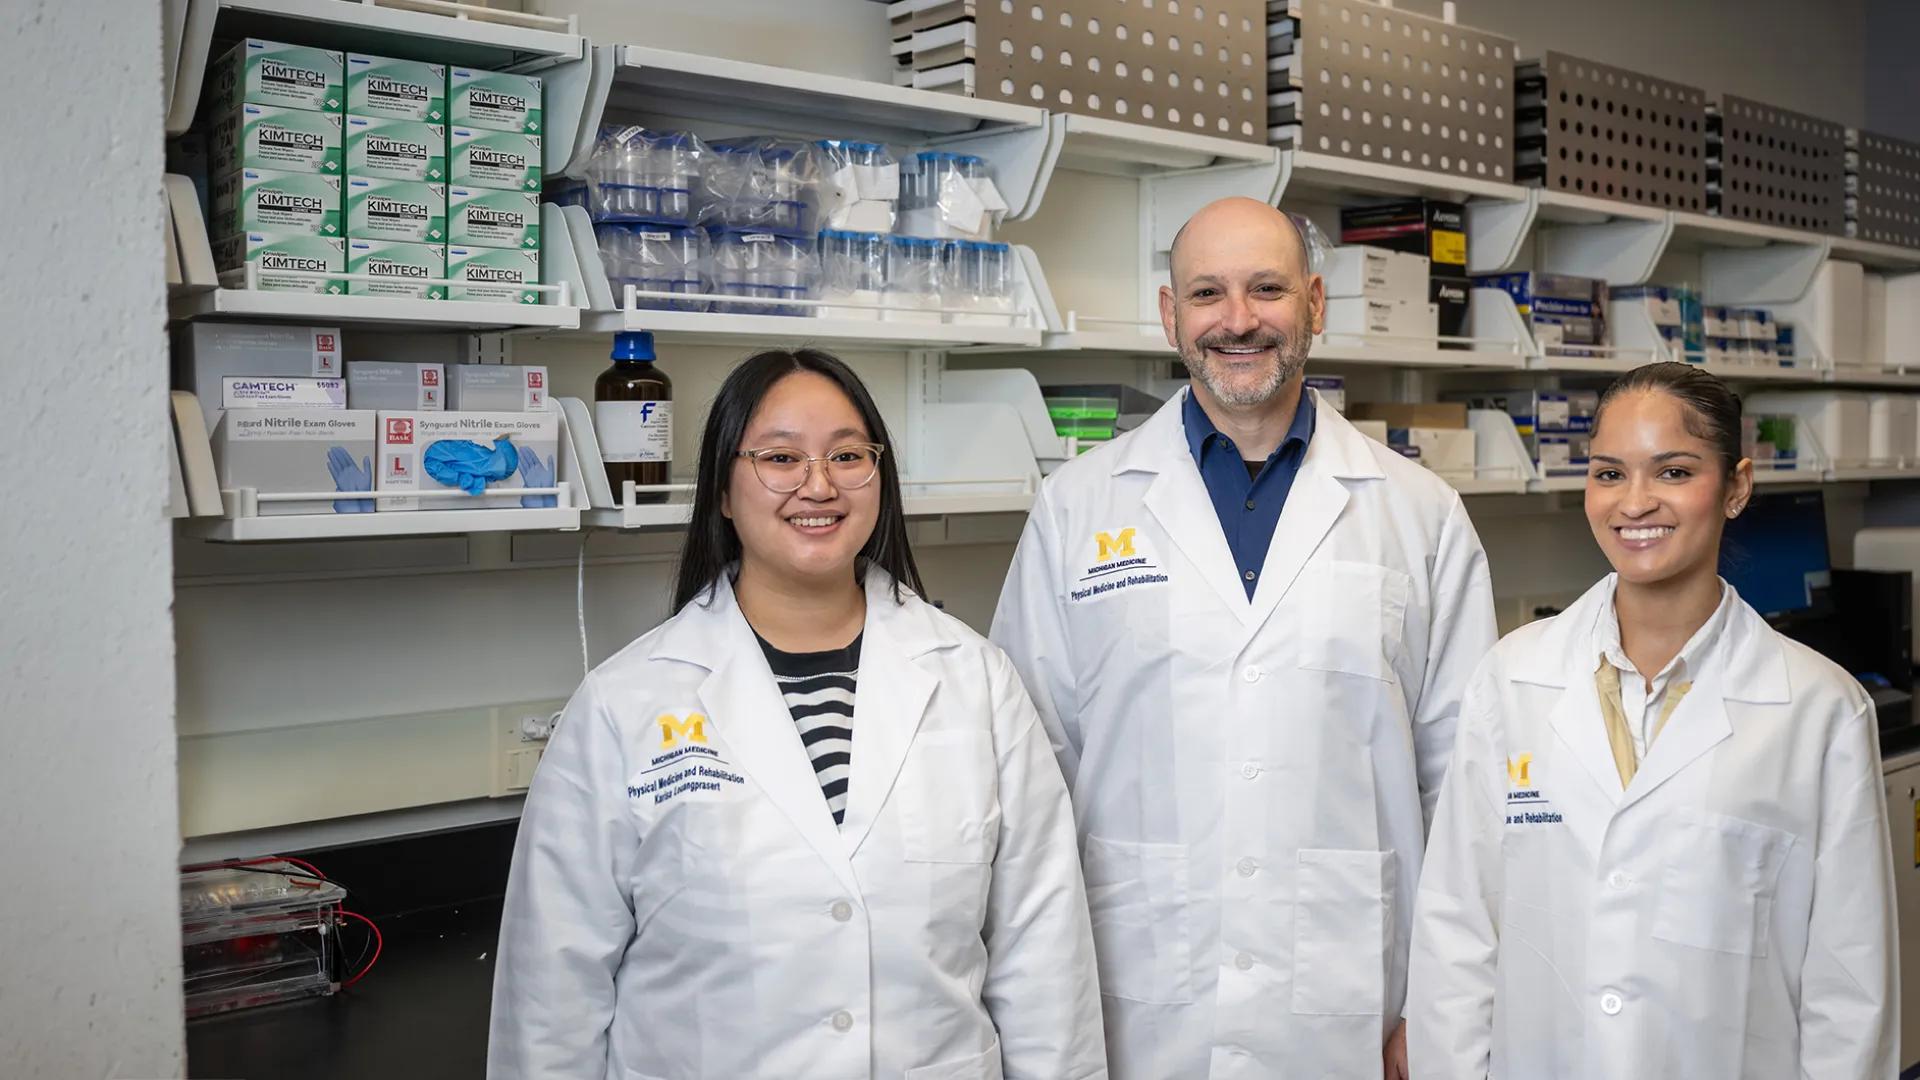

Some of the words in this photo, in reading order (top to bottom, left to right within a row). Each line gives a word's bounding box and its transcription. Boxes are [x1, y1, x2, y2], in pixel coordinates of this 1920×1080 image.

[261, 64, 325, 82] KIMTECH
[368, 79, 428, 95] KIMTECH
[470, 91, 525, 107] KIMTECH
[259, 129, 323, 145] KIMTECH
[367, 140, 427, 154] KIMTECH
[470, 151, 525, 164] KIMTECH
[258, 194, 322, 208] KIMTECH
[368, 201, 427, 214] KIMTECH
[468, 210, 523, 222] KIMTECH
[262, 257, 326, 270] KIMTECH
[369, 263, 428, 276] KIMTECH
[467, 269, 522, 280] KIMTECH
[232, 382, 295, 391] CAMTECH
[264, 418, 301, 428] Nitrile
[420, 420, 458, 430] Synguard
[460, 419, 493, 428] Nitrile
[395, 457, 405, 470] L
[1095, 527, 1136, 562] M
[1088, 562, 1115, 574] MICHIGAN
[1116, 558, 1146, 568] MEDICINE
[1071, 587, 1092, 601] Physical
[1093, 582, 1115, 594] Medicine
[1116, 578, 1126, 589] and
[1127, 574, 1168, 586] Rehabilitation
[656, 712, 708, 750] M
[652, 748, 683, 766] MICHIGAN
[684, 746, 719, 757] MEDICINE
[628, 781, 657, 798] Physical
[658, 772, 683, 787] Medicine
[684, 766, 696, 777] and
[699, 766, 745, 784] Rehabilitation
[1514, 790, 1540, 799] MEDICINE
[1514, 814, 1523, 824] and
[1525, 812, 1562, 823] Rehabilitation
